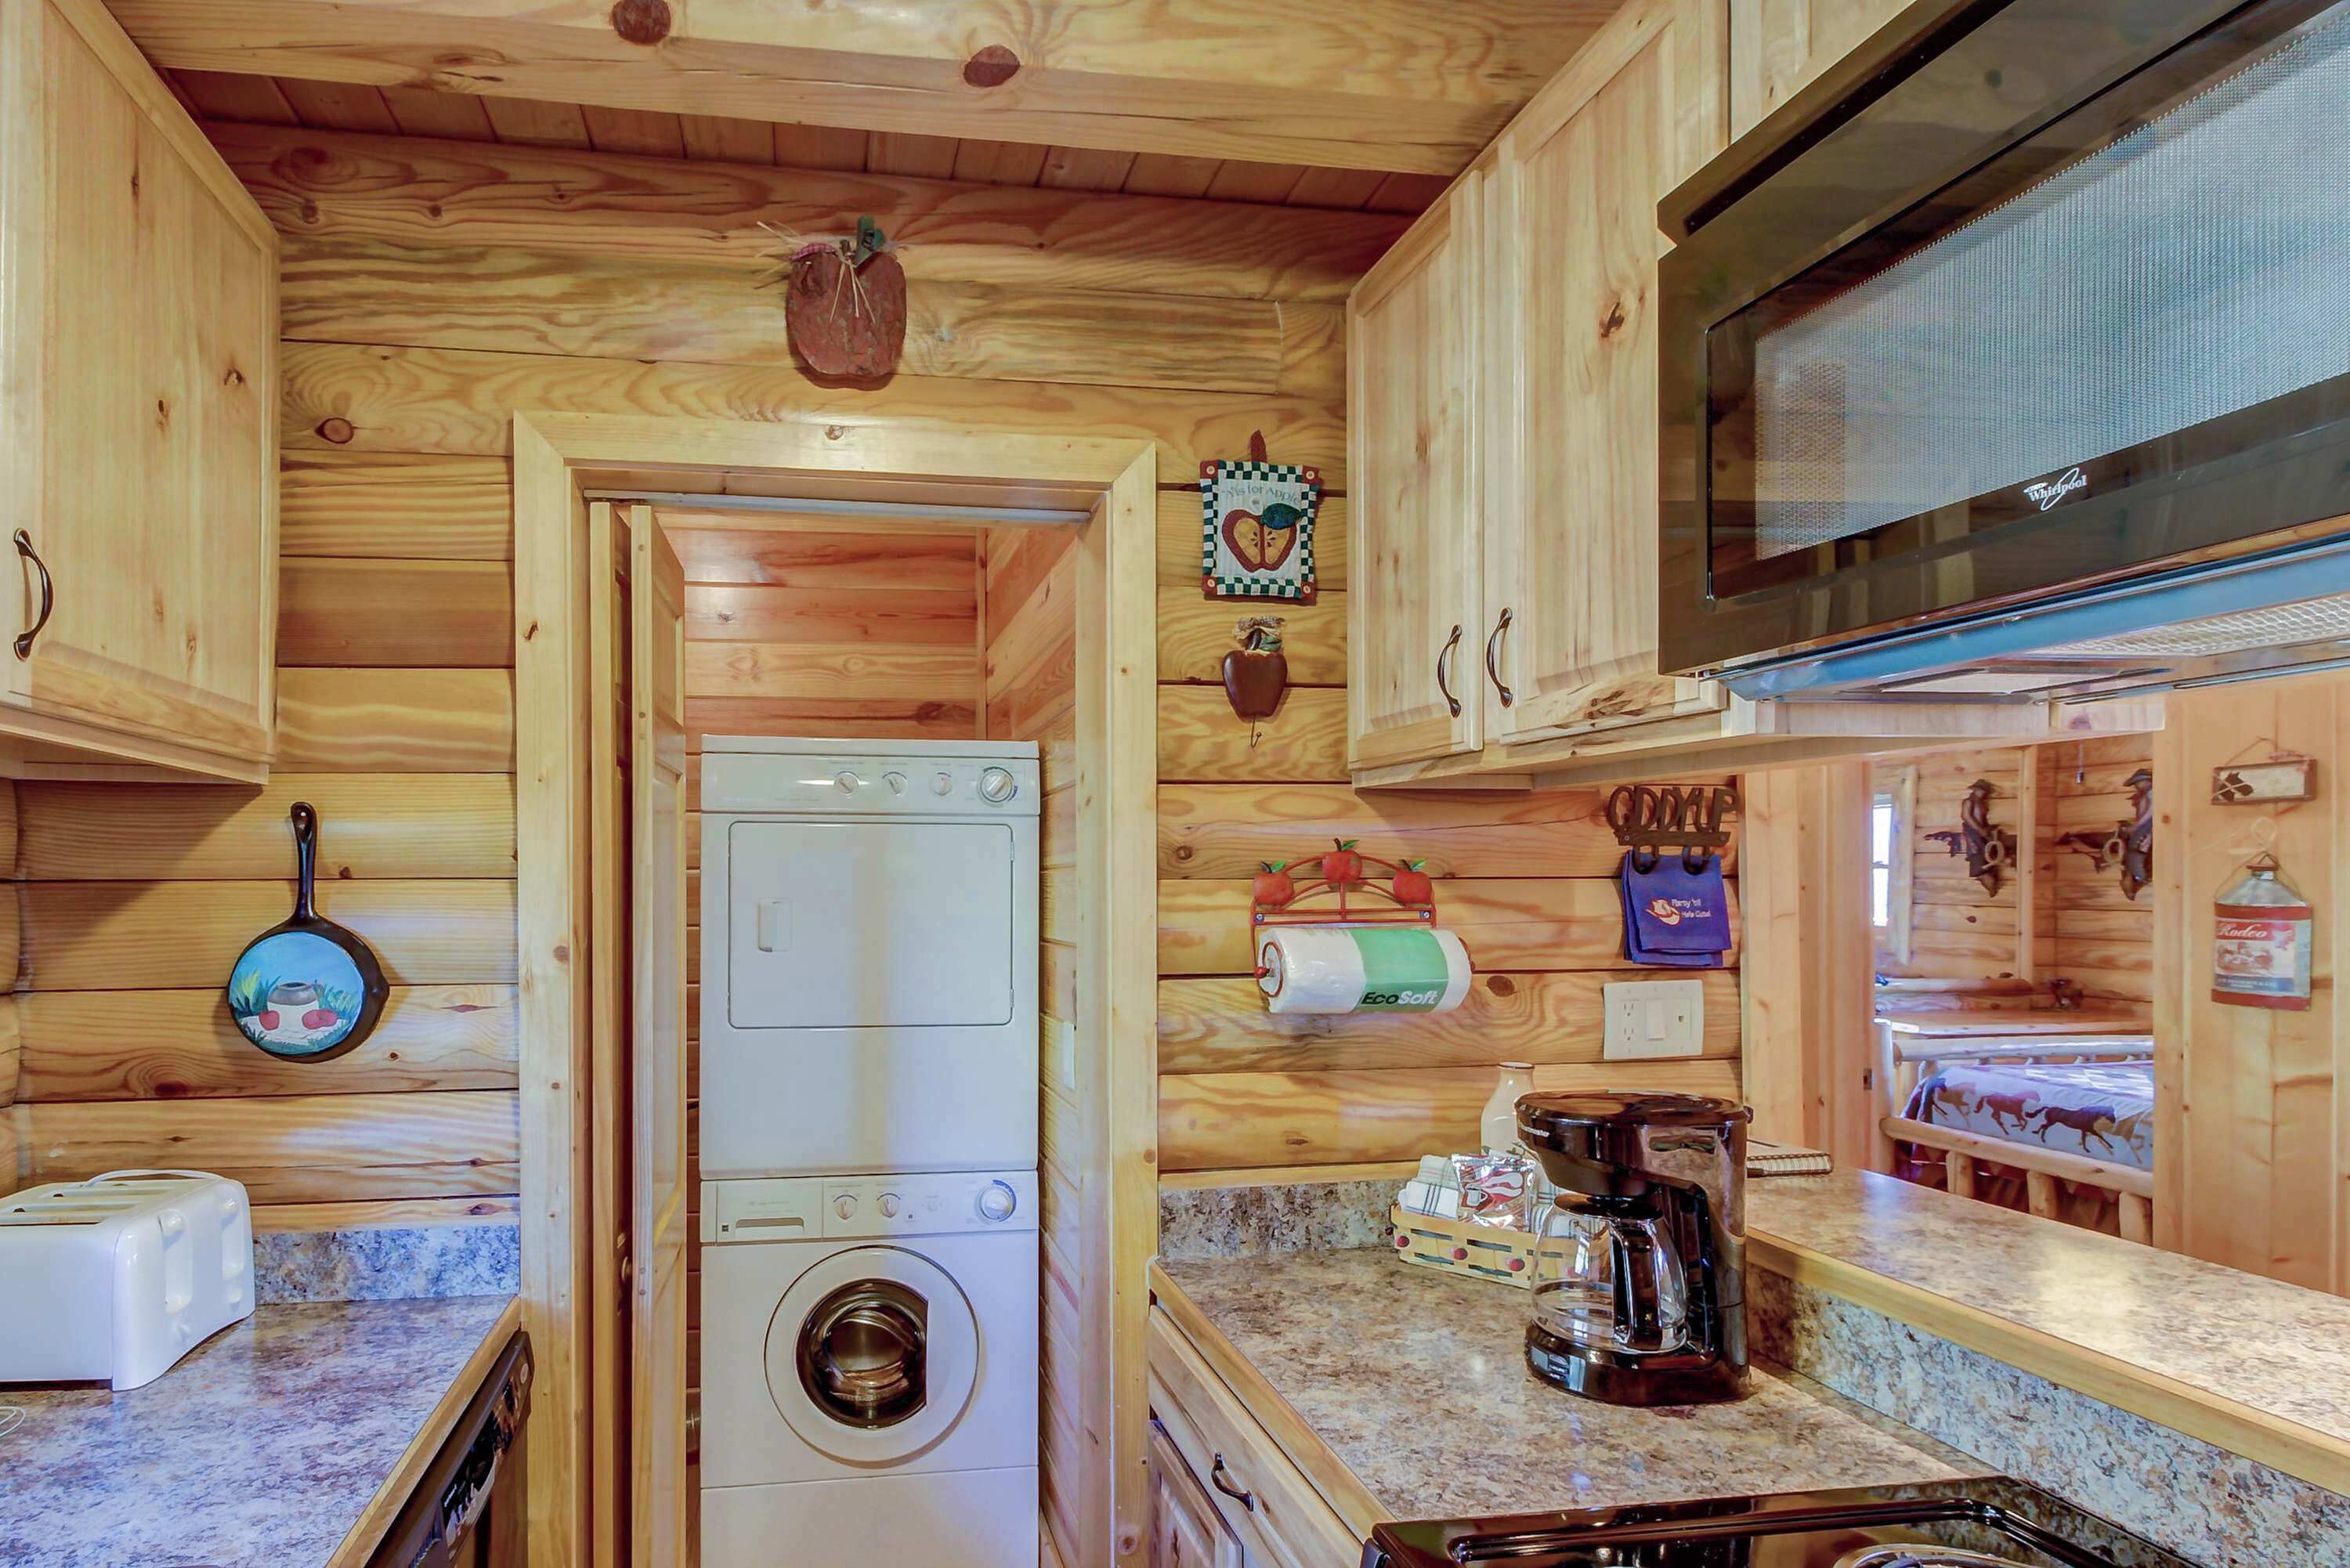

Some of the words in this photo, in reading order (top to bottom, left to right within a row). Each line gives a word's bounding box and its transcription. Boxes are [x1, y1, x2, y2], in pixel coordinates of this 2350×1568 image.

[2027, 468, 2088, 511] Whirlpool
[2218, 923, 2269, 938] Rodeo
[1361, 990, 1438, 1005] EcoSoft
